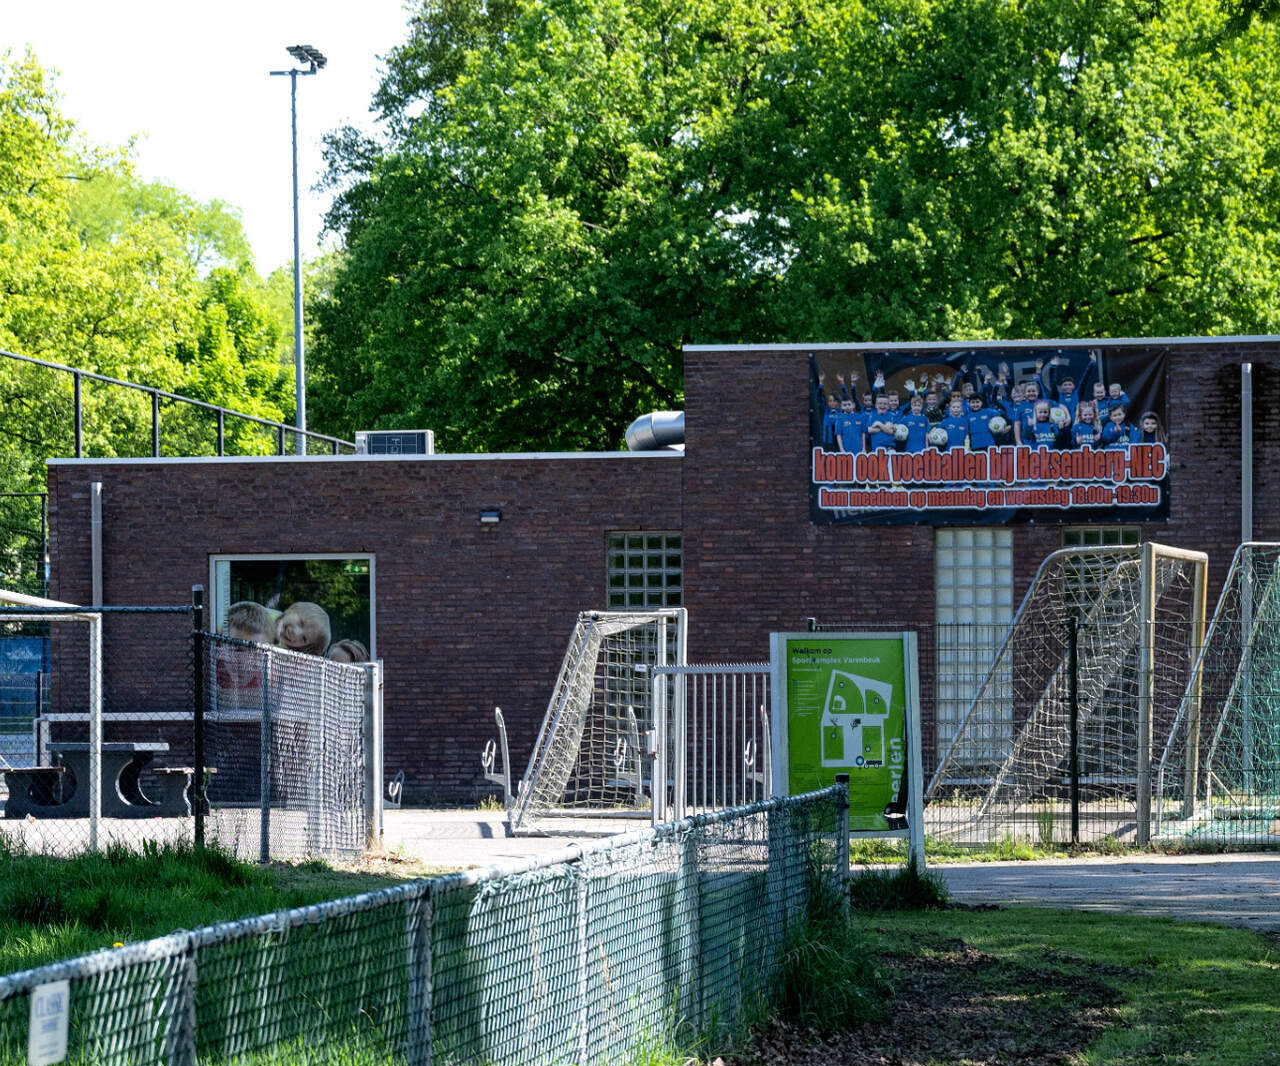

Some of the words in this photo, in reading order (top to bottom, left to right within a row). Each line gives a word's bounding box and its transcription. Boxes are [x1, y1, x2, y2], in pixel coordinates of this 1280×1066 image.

[814, 448, 854, 481] kom
[856, 448, 890, 481] ook
[891, 448, 988, 481] voetballen
[989, 446, 1014, 483] bij
[1017, 445, 1165, 482] Heksenberg-NEC
[821, 488, 848, 507] kom
[850, 489, 908, 507] meedoen
[909, 491, 926, 508] op
[928, 488, 986, 508] maandag
[987, 490, 1004, 506] en
[1005, 487, 1069, 506] woensdag
[1072, 486, 1158, 504] 18:00u-19:30u
